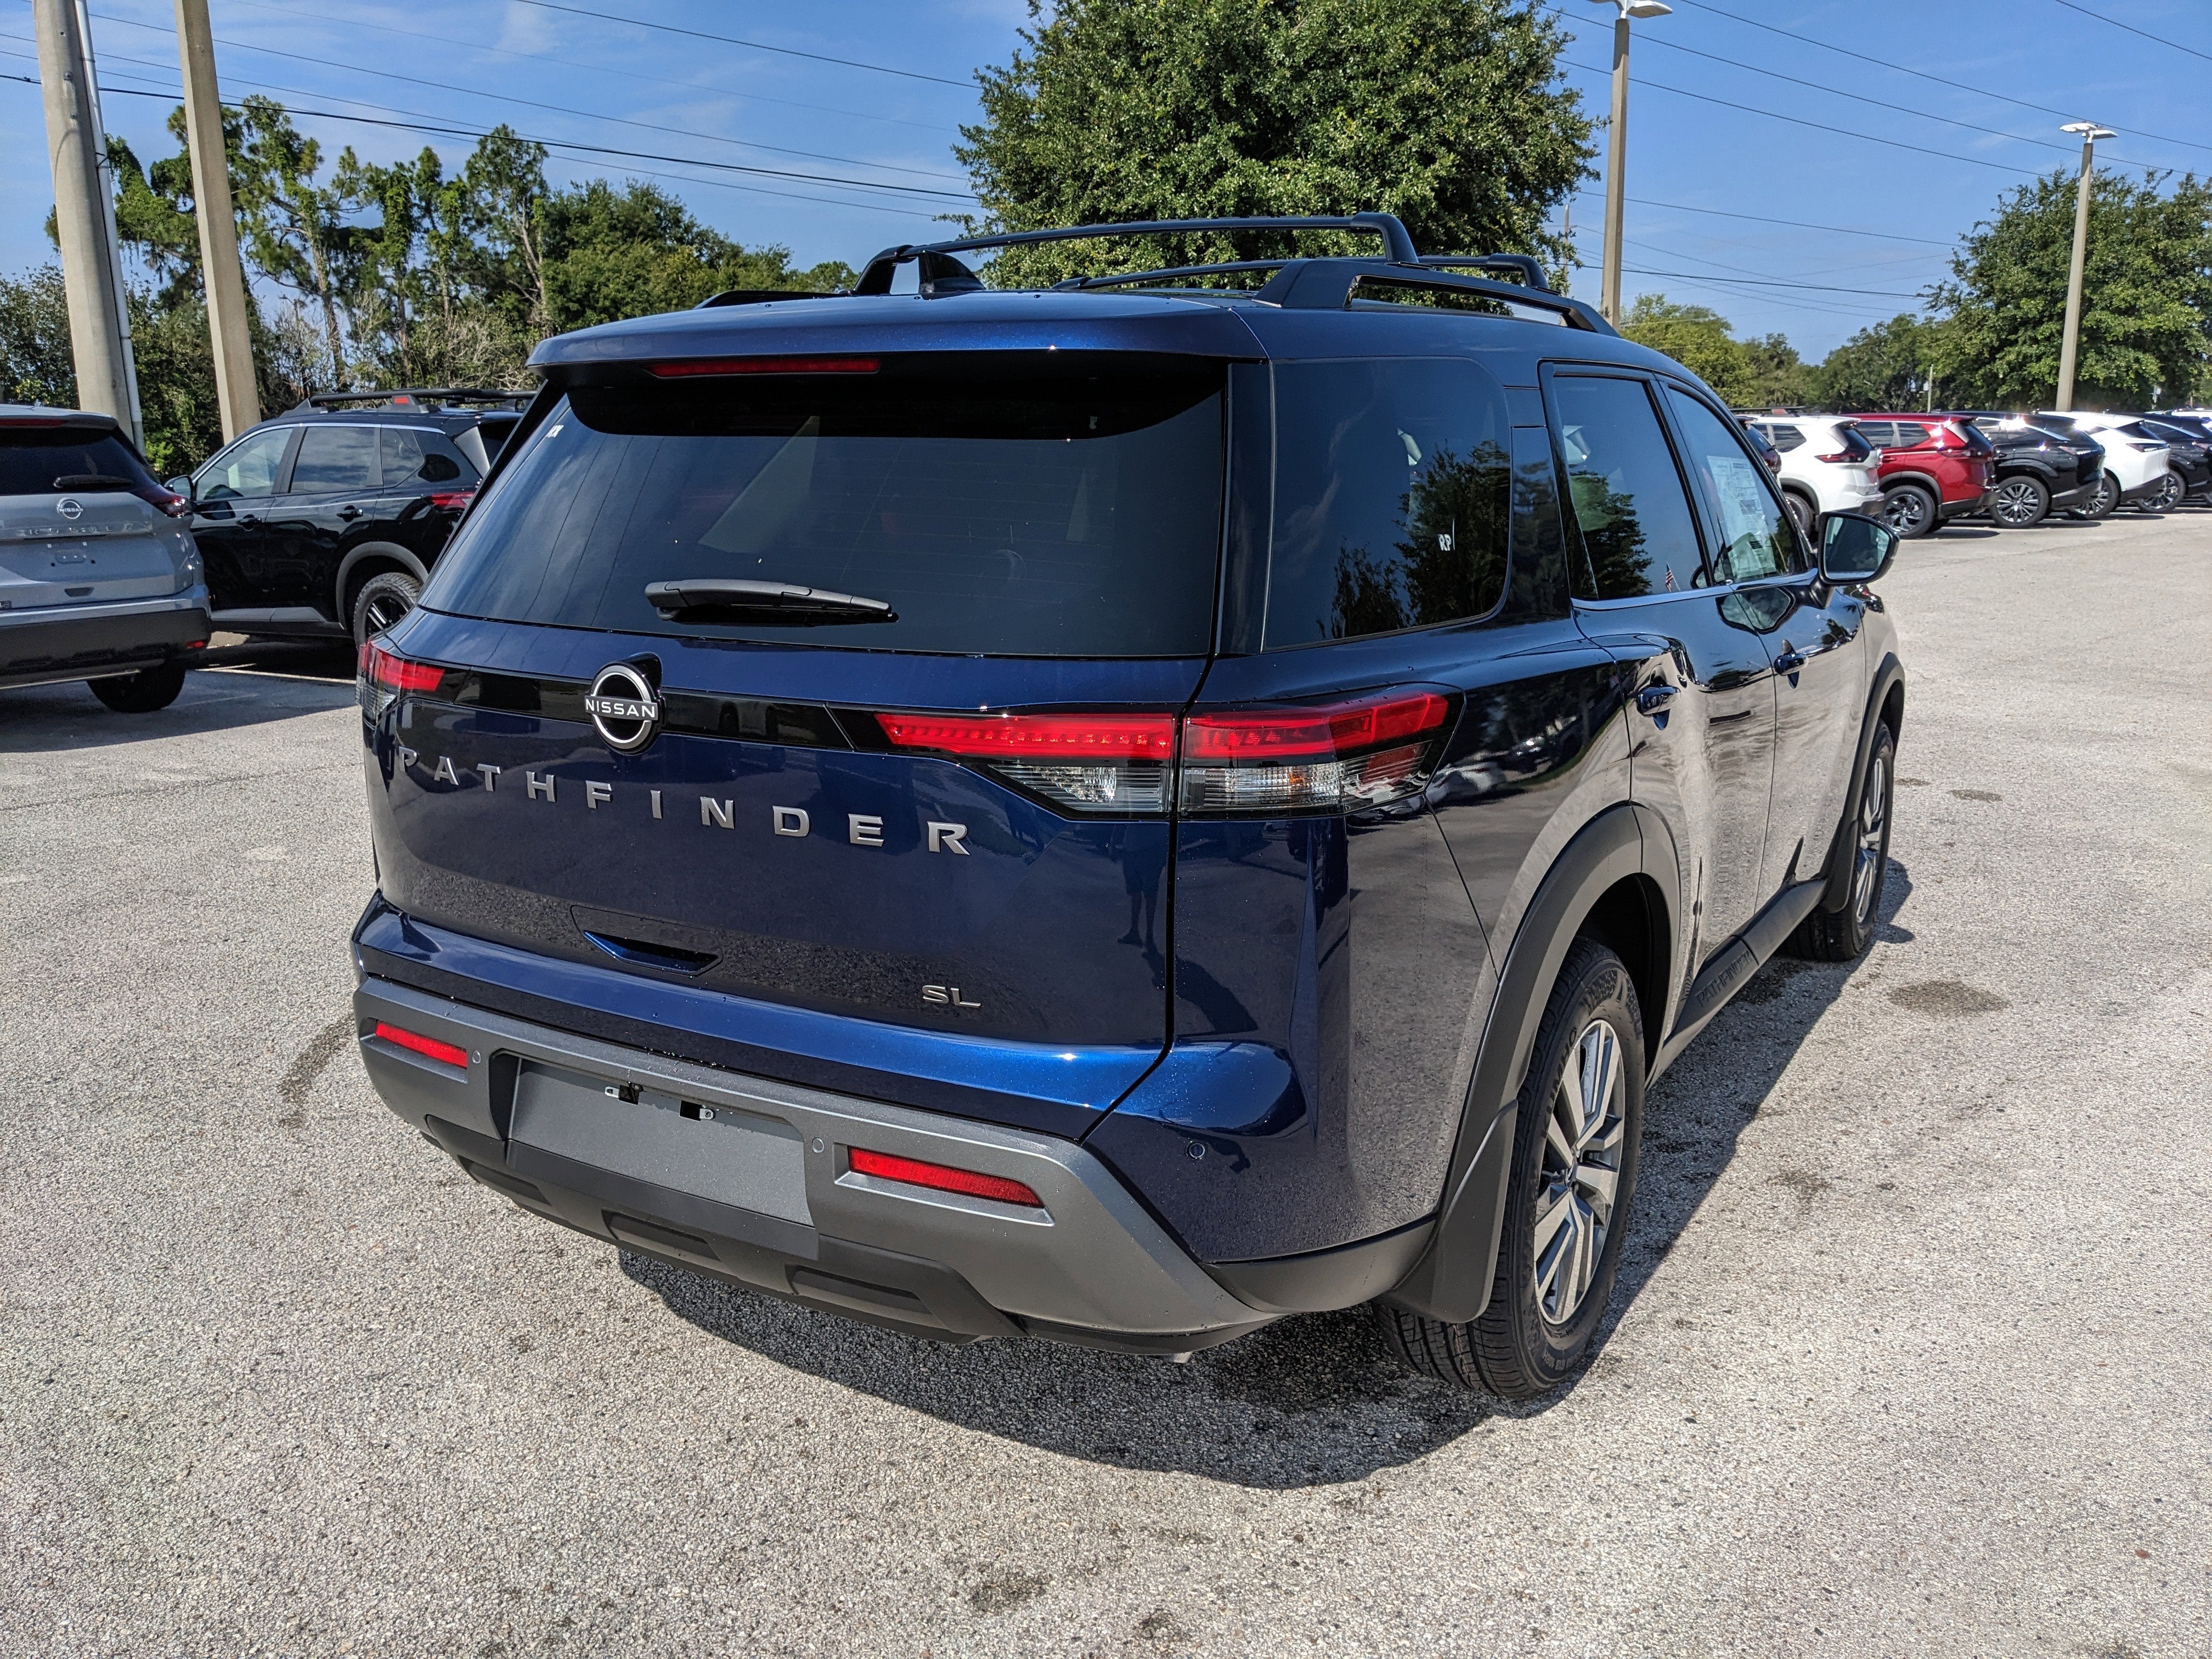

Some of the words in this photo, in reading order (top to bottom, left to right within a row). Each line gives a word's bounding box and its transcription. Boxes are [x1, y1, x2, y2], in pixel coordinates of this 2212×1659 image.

[585, 698, 655, 718] NISSAN
[398, 746, 970, 856] PATHFINDER
[922, 984, 981, 1008] SL
